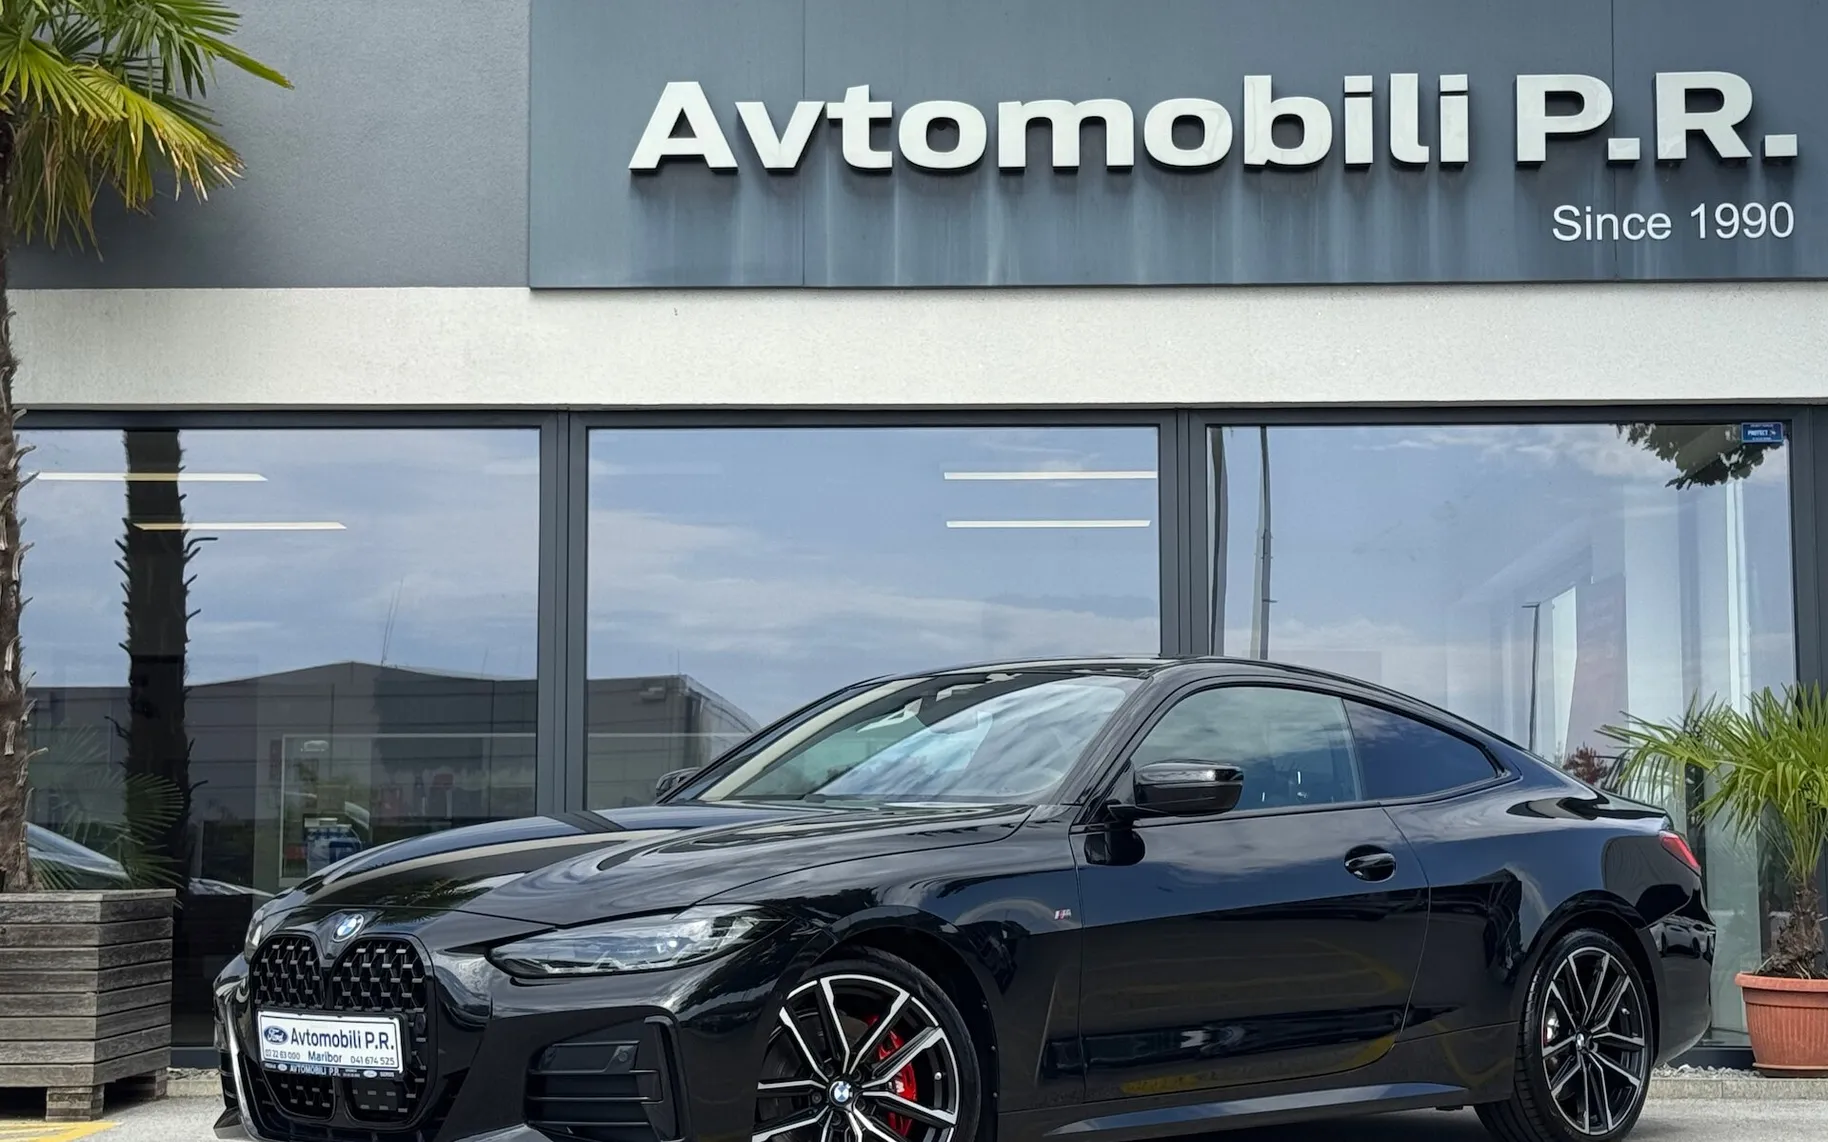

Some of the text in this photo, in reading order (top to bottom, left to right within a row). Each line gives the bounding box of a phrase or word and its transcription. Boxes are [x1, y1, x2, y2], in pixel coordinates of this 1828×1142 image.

[628, 71, 1798, 170] Avtomobili P.R.
[1552, 201, 1795, 241] Since 1990
[267, 1027, 285, 1042] Ford
[291, 1027, 394, 1050] Avtomobili P.R.
[288, 1051, 301, 1060] 000
[308, 1050, 342, 1063] Maribor
[350, 1055, 395, 1065] 041 674 525
